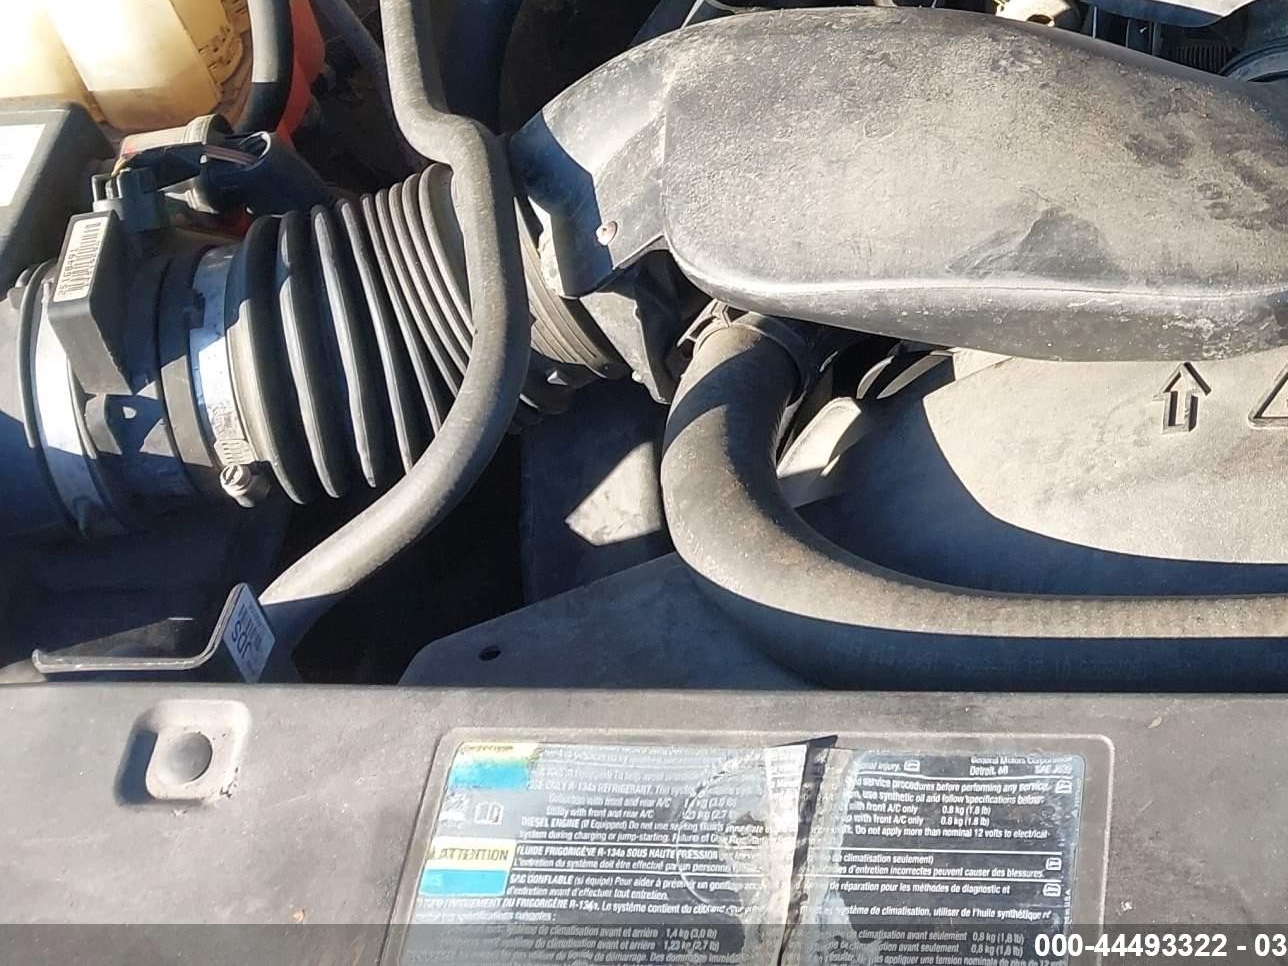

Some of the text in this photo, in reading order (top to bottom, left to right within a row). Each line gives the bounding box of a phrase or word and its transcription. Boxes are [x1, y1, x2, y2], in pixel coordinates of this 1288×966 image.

[863, 777, 1017, 793] service procedures before performing any
[878, 791, 914, 801] synthetic
[926, 794, 940, 802] and
[942, 795, 964, 803] follow
[588, 808, 606, 817] front
[608, 810, 622, 818] and
[639, 810, 654, 819] A/C
[867, 802, 885, 812] front
[887, 804, 901, 813] A/C
[902, 806, 918, 814] only
[942, 806, 953, 814] 0.8
[955, 806, 964, 815] kg
[982, 806, 991, 815] lb)
[521, 816, 668, 830] DIESEL ENGINE Equipped) Do not use
[873, 815, 891, 823] front
[893, 816, 906, 824] A/C
[908, 816, 923, 826] only
[954, 817, 963, 826] kg
[980, 817, 989, 826] lb)
[548, 831, 572, 840] during
[574, 831, 606, 841] charging
[617, 833, 670, 843] jump-starting.
[855, 825, 866, 834] Do
[868, 825, 880, 834] not
[882, 827, 902, 837] apply
[904, 828, 923, 836] more
[925, 828, 940, 836] than
[943, 828, 972, 837] nominal
[985, 829, 1002, 838] volts
[441, 848, 508, 861] ATTENTION
[626, 849, 648, 857] SOUS
[649, 849, 675, 859] HAUTE
[844, 854, 934, 865] climatisation seulement)
[555, 859, 566, 867] du
[600, 860, 614, 868] doit
[616, 860, 630, 869] être
[848, 865, 889, 874] d'entretien
[890, 866, 931, 875] incorrectes
[933, 868, 963, 877] peuvent
[965, 869, 989, 877] causer
[992, 869, 1005, 877] des
[510, 874, 526, 884] SAC
[574, 876, 583, 885] (si
[614, 877, 632, 886] Pour
[633, 877, 654, 887] aider
[655, 877, 661, 887] à
[697, 881, 708, 889] un
[549, 888, 570, 896] avant
[572, 888, 612, 897] d'effectuer
[614, 889, 629, 898] tout
[631, 890, 669, 900] entretien.
[841, 882, 879, 892] réparation
[880, 884, 898, 892] pour
[899, 883, 911, 891] les
[912, 883, 949, 892] méthodes
[951, 884, 960, 892] de
[962, 884, 1000, 895] diagnostic
[648, 903, 679, 913] contient
[681, 904, 692, 913] du
[870, 906, 881, 915] de
[934, 908, 959, 917] utiliser
[961, 908, 970, 917] de
[972, 908, 995, 918] l'huile
[550, 925, 599, 936] climatisation
[599, 927, 622, 936] avant
[623, 928, 631, 937] et
[632, 927, 658, 938] arrière
[679, 929, 689, 939] kg
[707, 929, 717, 939] lb)
[907, 932, 927, 940] avant
[929, 932, 967, 940] seulement
[986, 933, 995, 943] kg
[597, 940, 619, 950] avant
[620, 941, 629, 950] et
[629, 941, 655, 950] arrière
[899, 943, 919, 952] avant
[921, 943, 959, 953] seulement
[985, 945, 994, 954] kg
[884, 955, 918, 965] appliquer
